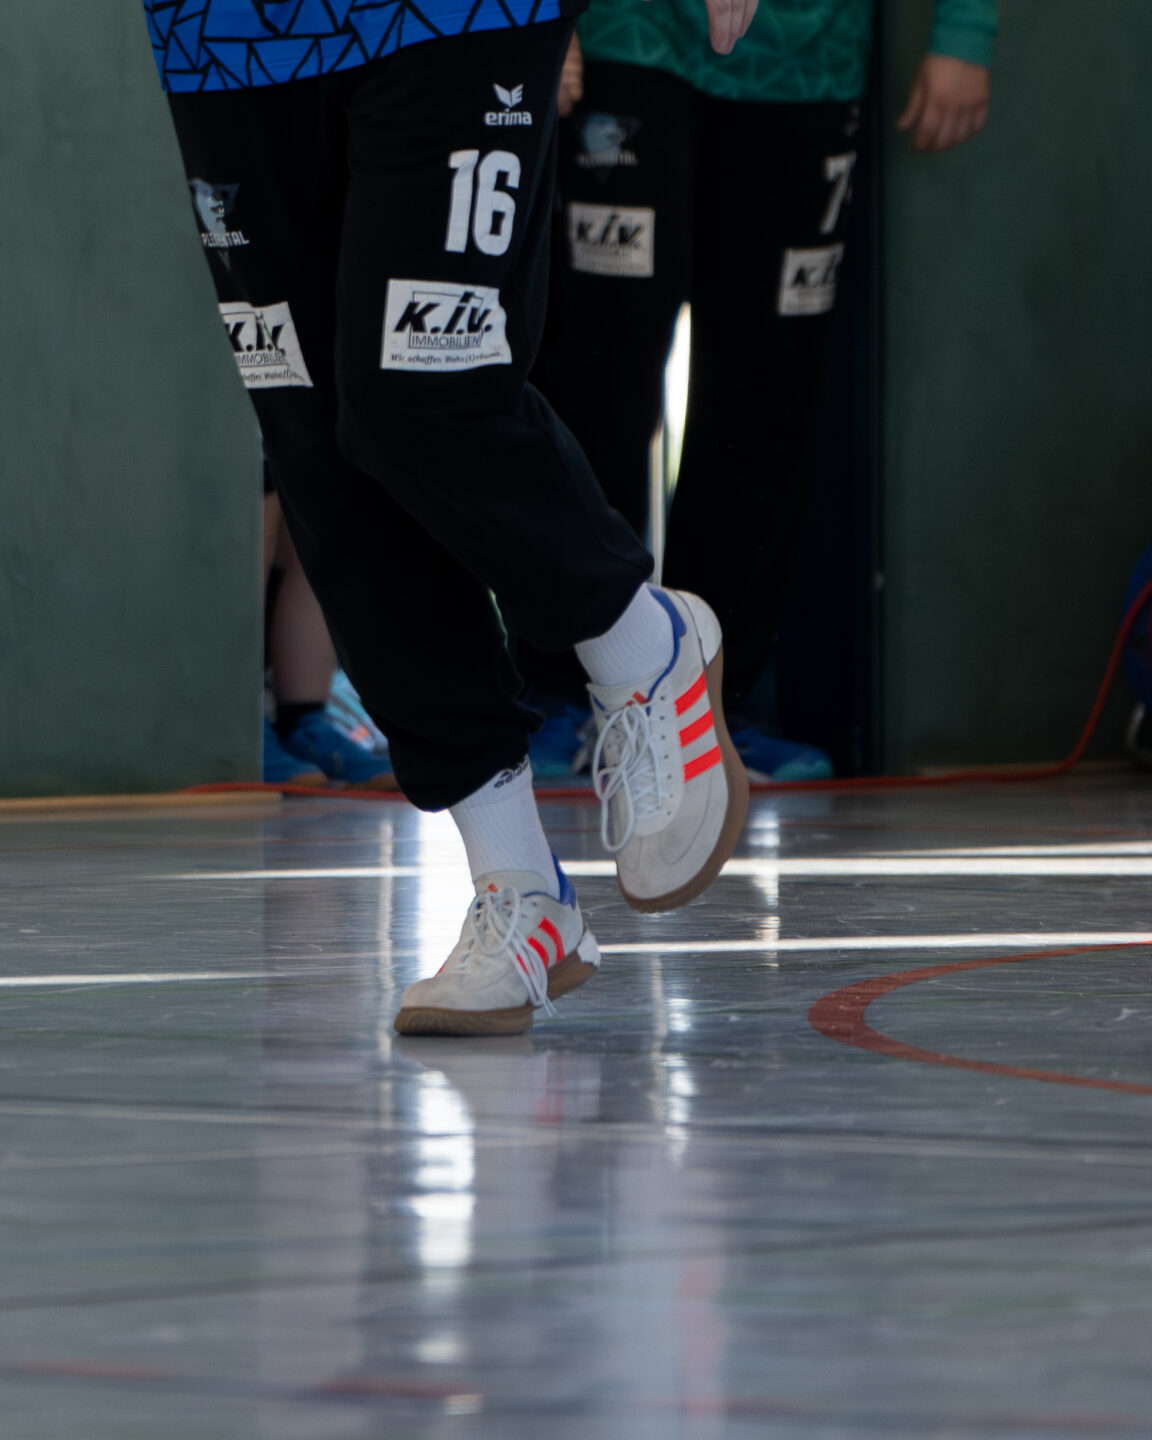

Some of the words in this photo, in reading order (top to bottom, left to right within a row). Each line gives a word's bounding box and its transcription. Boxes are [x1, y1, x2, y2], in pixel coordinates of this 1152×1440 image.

[484, 108, 533, 126] erima
[445, 149, 521, 256] 16
[411, 335, 481, 348] IMMOBILIEN
